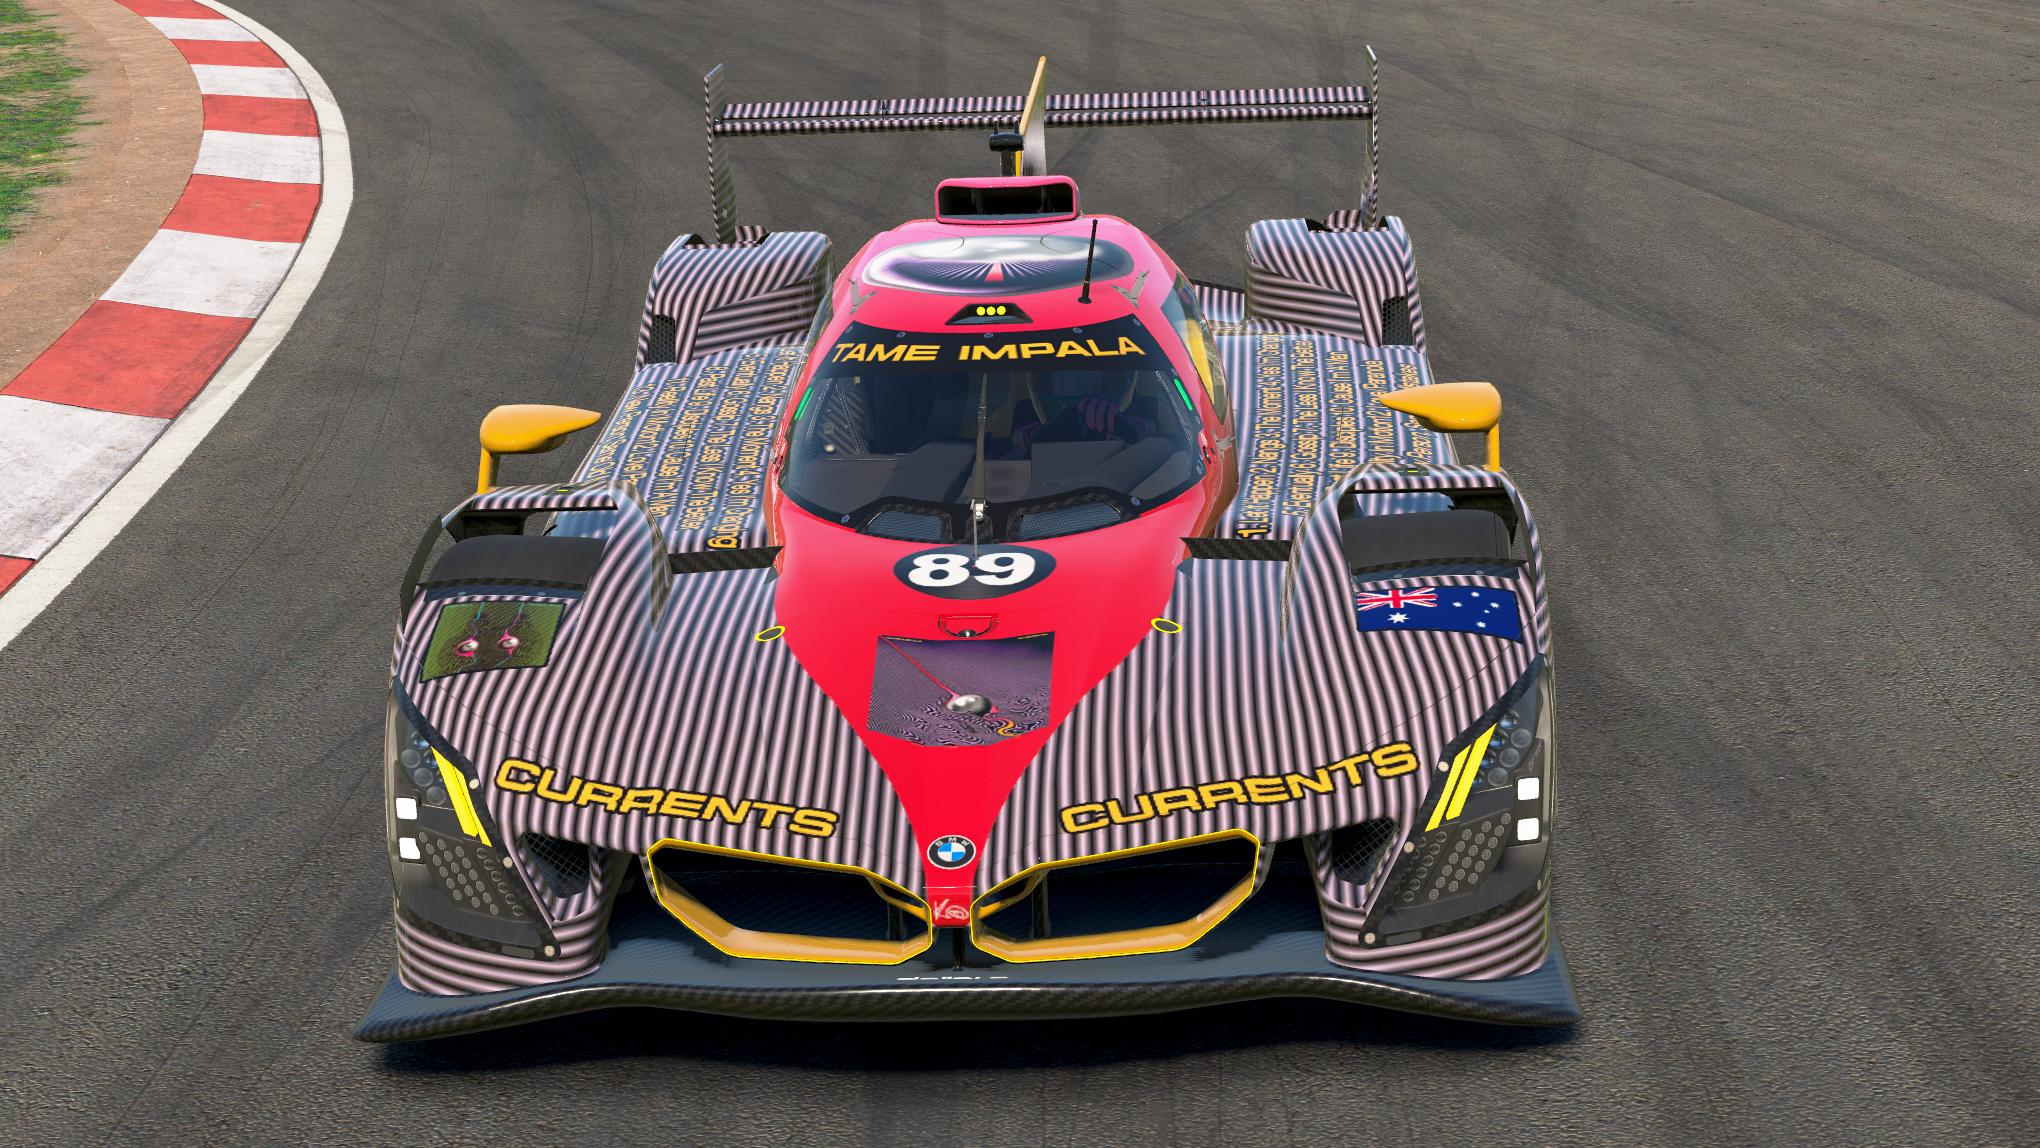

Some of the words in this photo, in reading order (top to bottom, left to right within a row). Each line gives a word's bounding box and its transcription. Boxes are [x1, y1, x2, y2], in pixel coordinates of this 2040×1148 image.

[831, 342, 941, 363] TAME
[957, 336, 1147, 361] IMPALA
[1293, 394, 1318, 409] Less
[1255, 416, 1281, 431] The
[1292, 411, 1319, 425] The
[700, 444, 731, 462] Less
[1251, 439, 1286, 464] Nangs
[730, 479, 759, 494] Yes
[1238, 510, 1269, 523] Let
[1236, 525, 1269, 538] 1.
[908, 552, 1036, 587] 89
[1060, 740, 1420, 834] CURRENTS
[494, 757, 840, 838] CURRENTS
[934, 836, 970, 847] BMW
